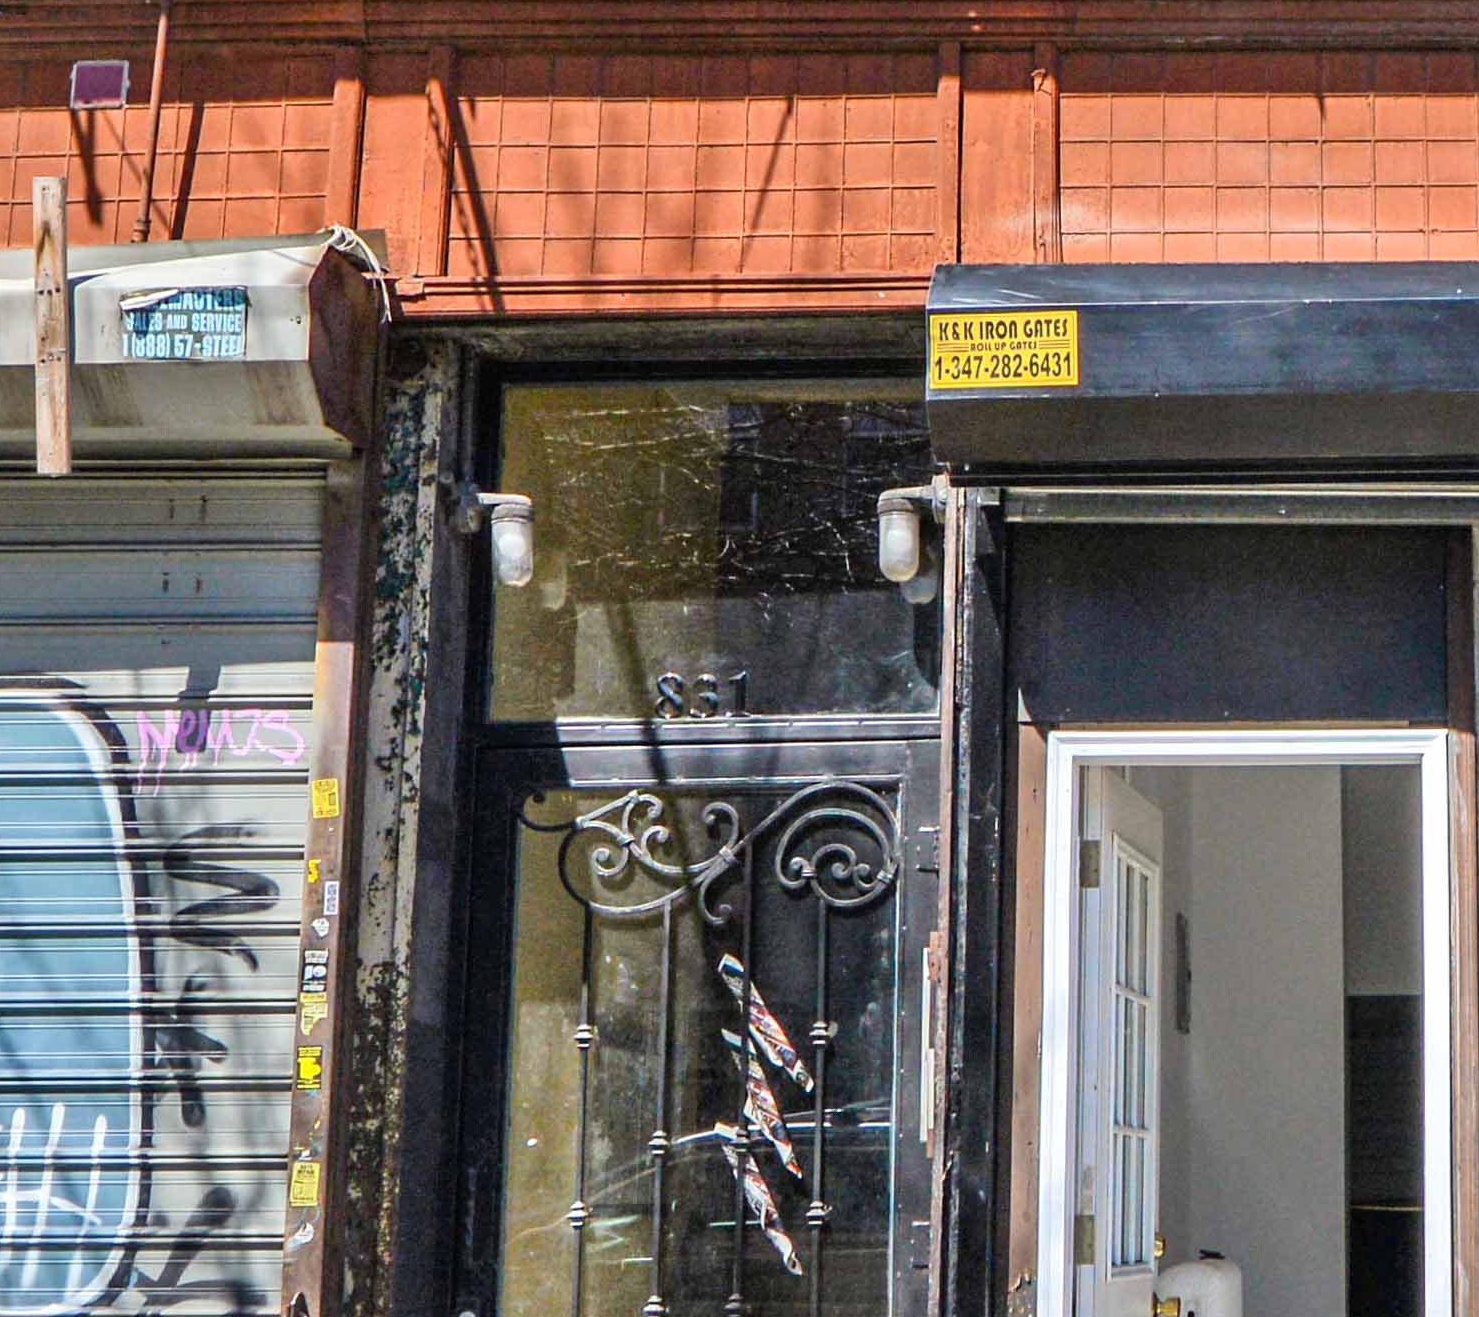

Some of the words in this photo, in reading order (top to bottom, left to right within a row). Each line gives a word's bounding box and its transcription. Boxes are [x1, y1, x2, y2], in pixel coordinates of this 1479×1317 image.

[126, 312, 162, 332] SALES
[166, 313, 187, 330] AND
[191, 312, 241, 332] SERVICE
[979, 320, 1018, 339] IRON
[1023, 318, 1068, 337] GATES
[131, 332, 170, 358] (888)
[970, 342, 992, 352] ROLL
[995, 342, 1006, 351] UP
[1009, 341, 1037, 350] GATES
[935, 351, 1071, 381] 1-347-282-6431
[655, 671, 752, 718] 831
